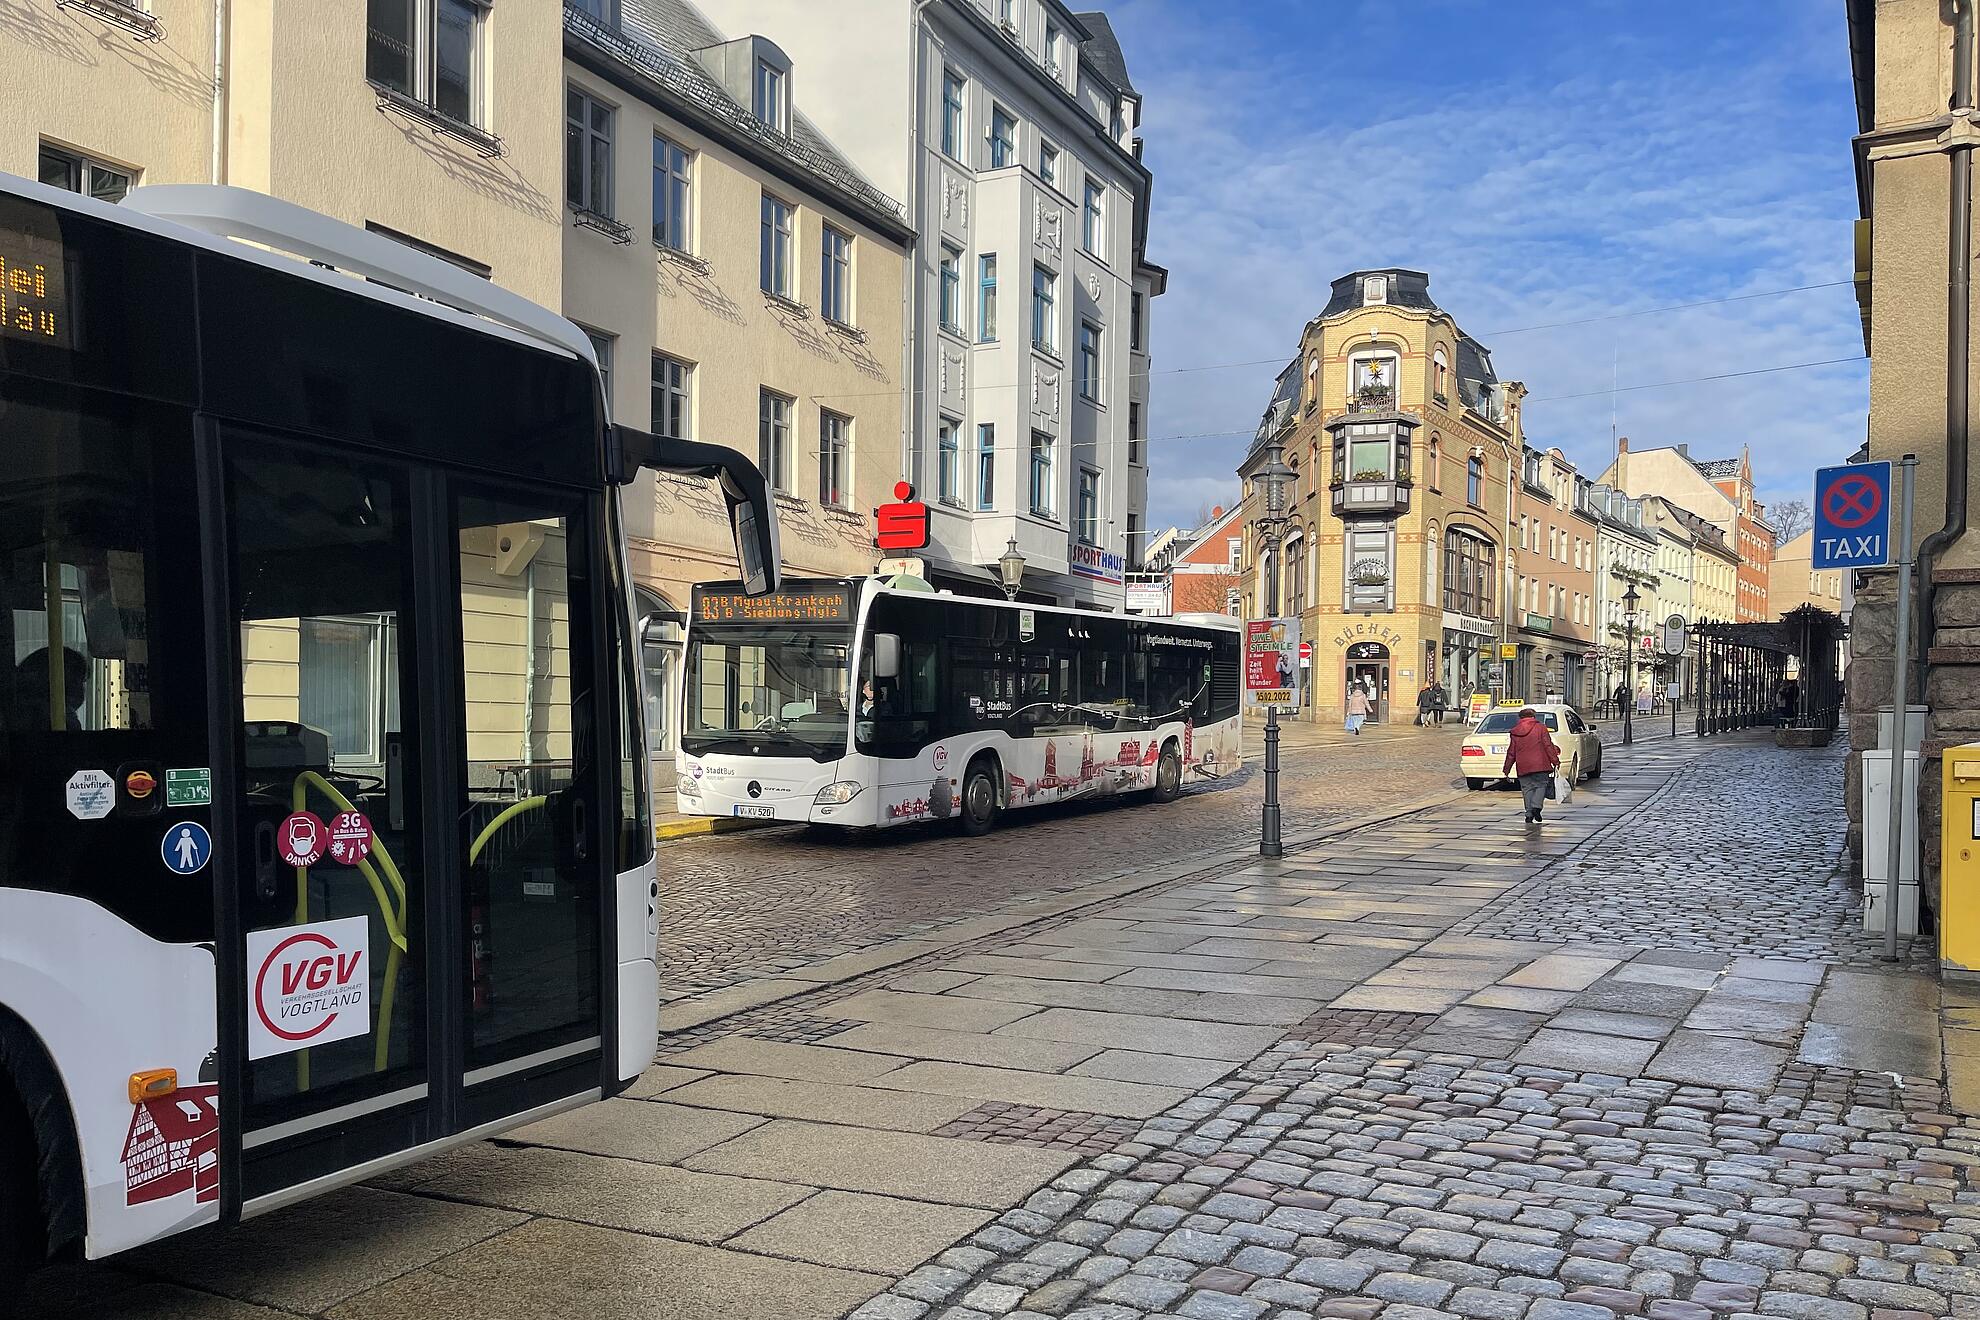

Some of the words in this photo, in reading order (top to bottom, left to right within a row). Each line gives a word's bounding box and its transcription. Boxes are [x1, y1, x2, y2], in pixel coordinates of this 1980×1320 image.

[1820, 535, 1880, 560] TAXI
[1073, 544, 1122, 572] SPORTHAUS
[1250, 633, 1272, 642] UWE
[1334, 623, 1402, 648] BÜCHER
[1249, 642, 1294, 652] STEIMLE
[987, 701, 1012, 711] StadtBus
[706, 766, 735, 776] StadtBus
[84, 774, 98, 782] Mit
[69, 780, 112, 790] Aktivfilter.
[757, 808, 771, 817] 520
[341, 812, 361, 828] 3G
[285, 850, 321, 867] DANKE!
[281, 950, 362, 996] VGV
[281, 991, 362, 1019] VOGTLAND
